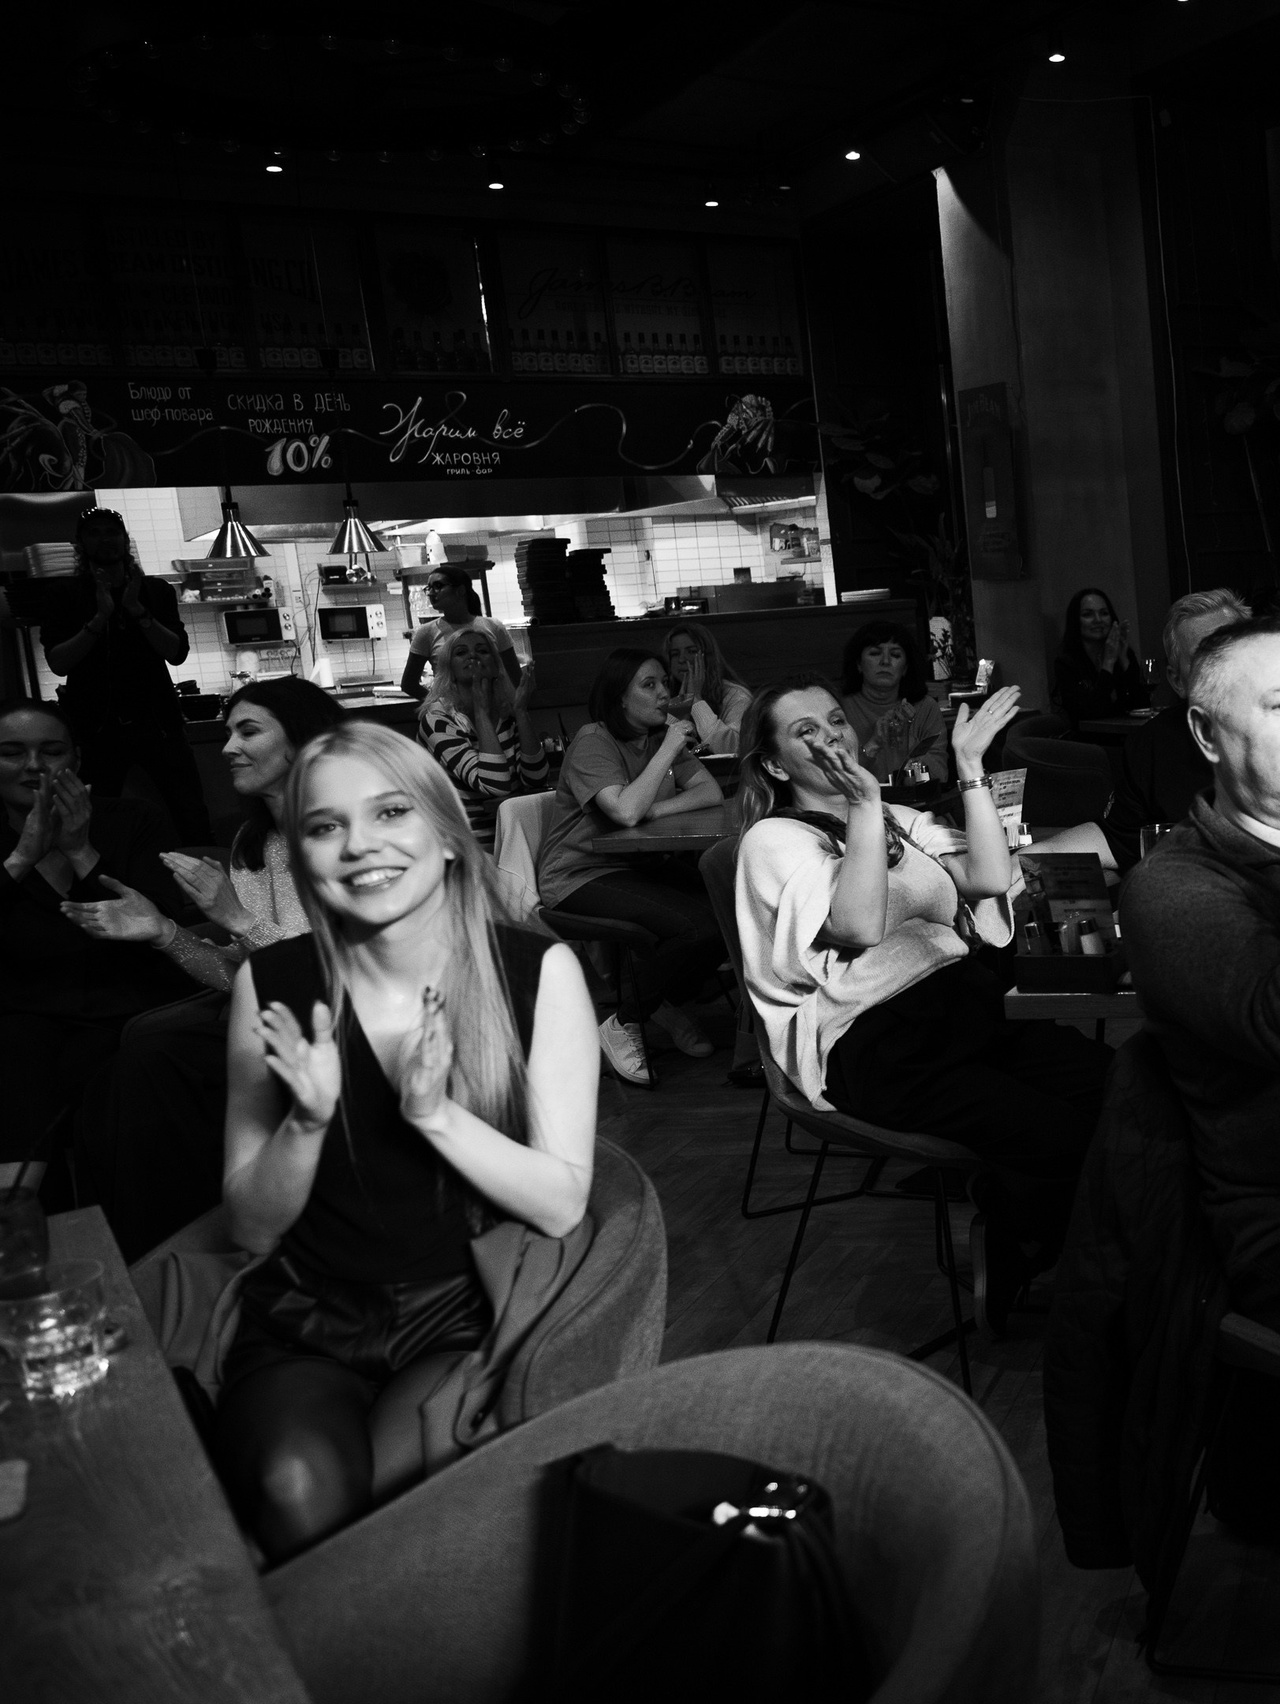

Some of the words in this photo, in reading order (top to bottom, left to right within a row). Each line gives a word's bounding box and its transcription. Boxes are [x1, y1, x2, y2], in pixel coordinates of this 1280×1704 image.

[127, 382, 172, 403] Блюдо
[178, 387, 193, 400] от
[314, 392, 351, 414] ДЕНЬ
[131, 405, 214, 427] шеф-повара
[248, 418, 315, 434] РОЖДЕНИЯ
[379, 396, 479, 463] Жарим
[492, 408, 527, 440] всё
[264, 433, 334, 476] 10%
[430, 452, 502, 465] ЖАРОВНЯ
